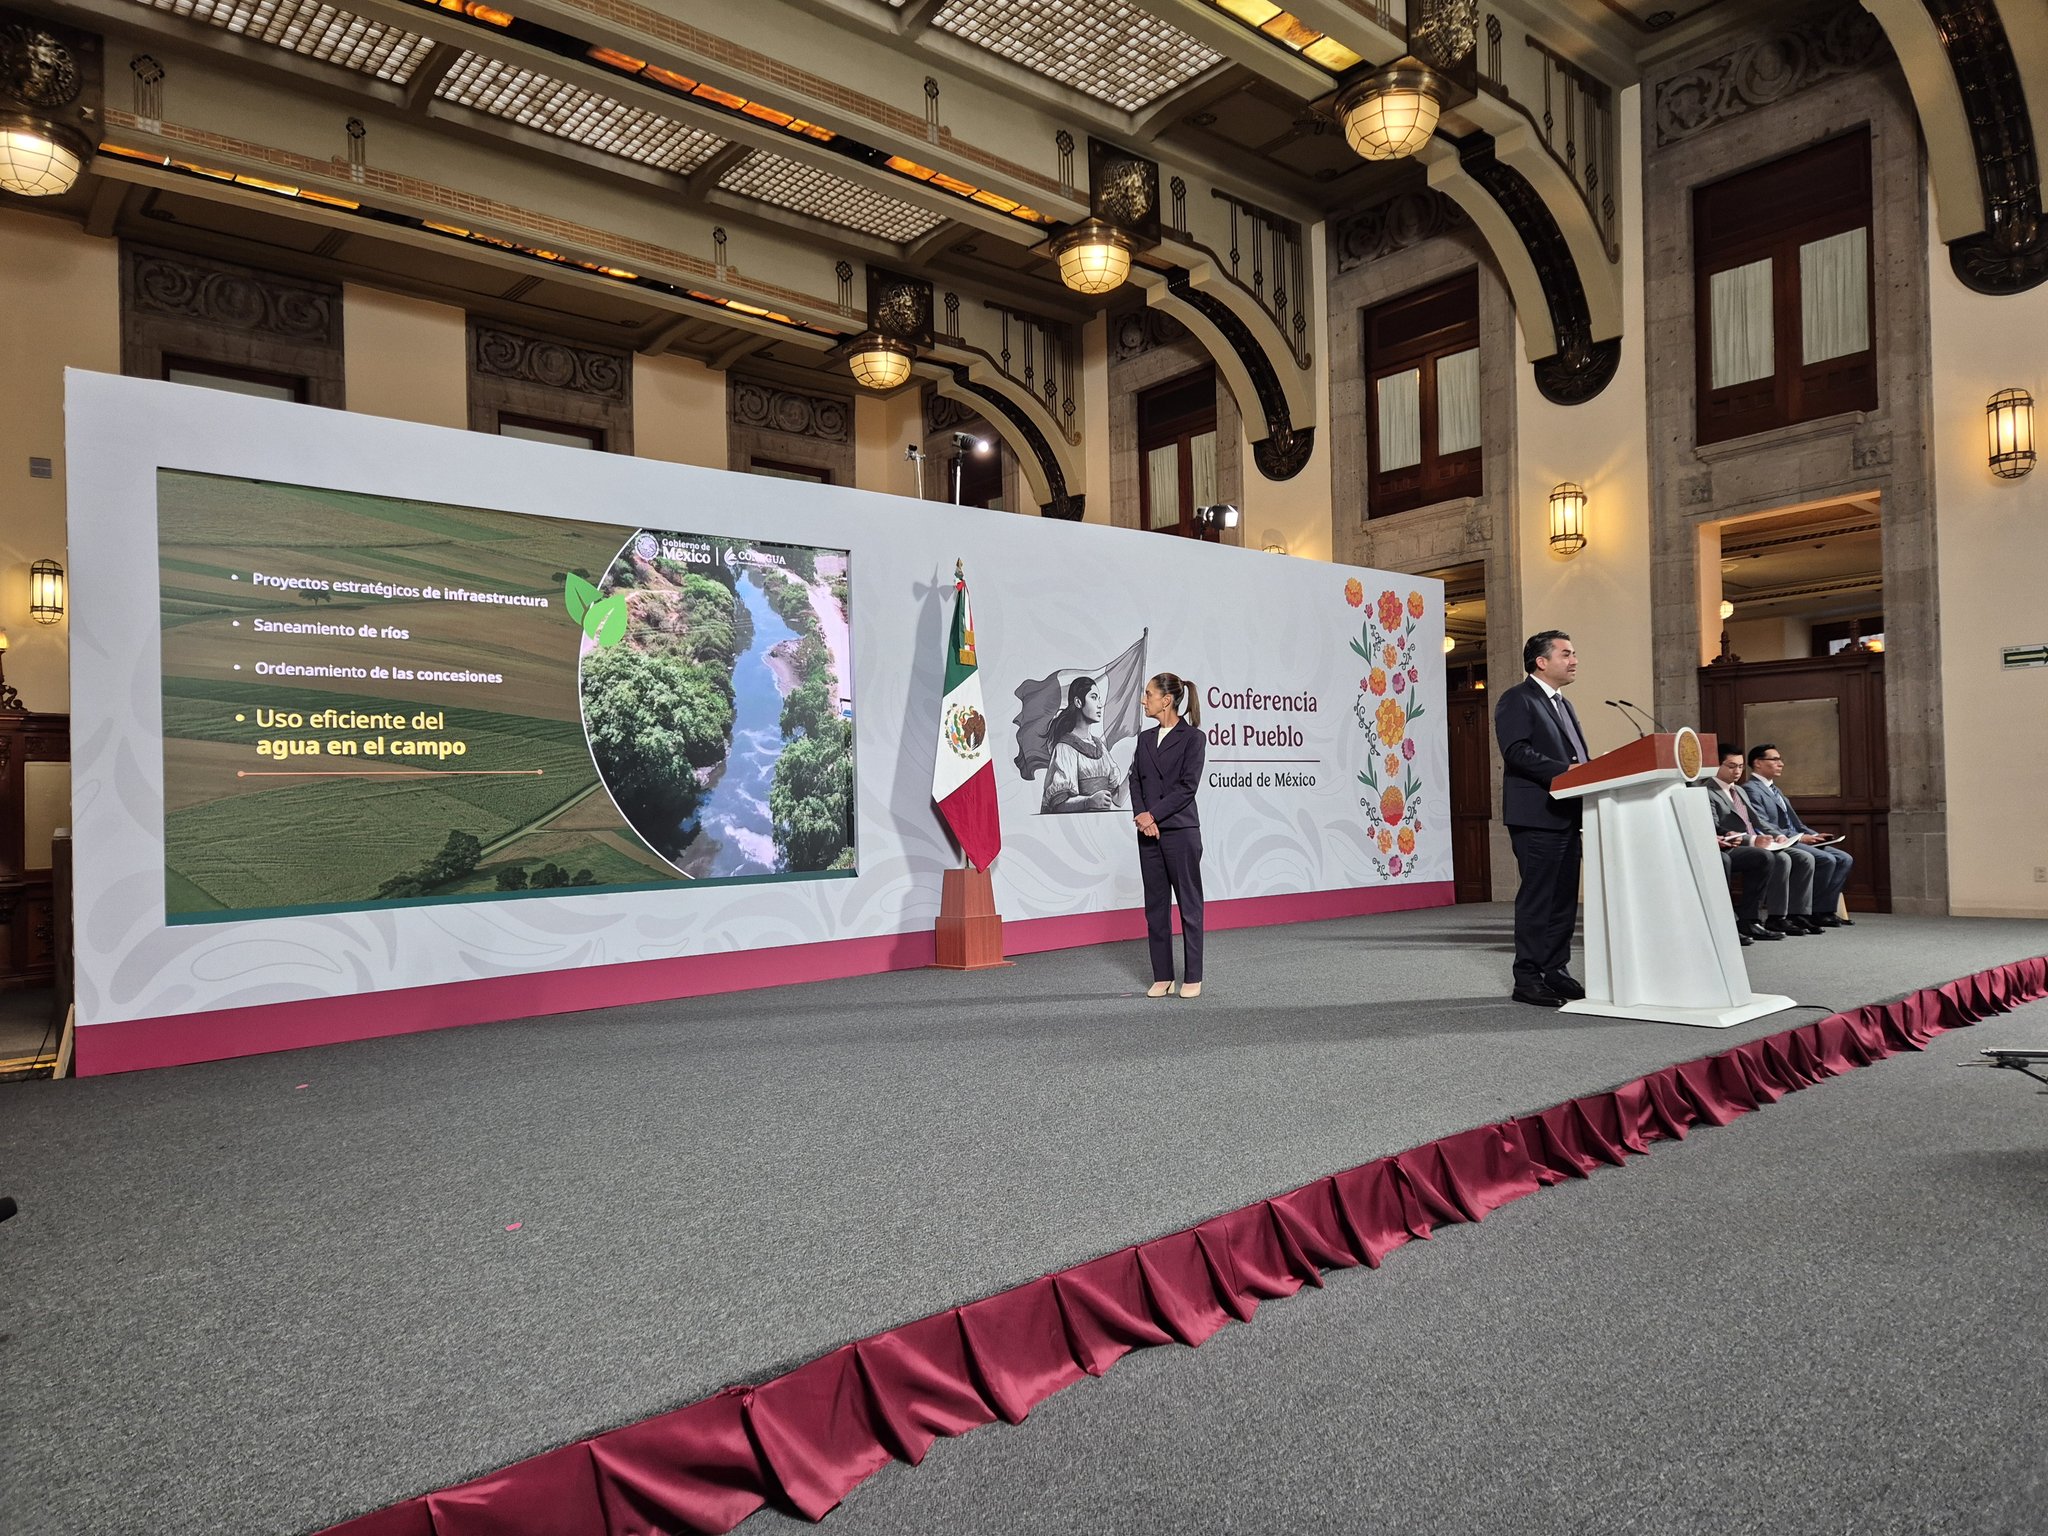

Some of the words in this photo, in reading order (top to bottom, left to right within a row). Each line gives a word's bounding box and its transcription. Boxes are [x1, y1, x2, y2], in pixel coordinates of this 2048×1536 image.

[662, 538, 700, 550] Gobierno
[700, 542, 711, 552] de
[662, 546, 711, 564] México
[738, 551, 787, 564] COGUA
[252, 572, 329, 590] Proyectos
[332, 580, 421, 599] estratégicos
[422, 585, 442, 600] de
[444, 587, 549, 608] infraestructura
[253, 618, 356, 637] Saneamiento
[358, 624, 379, 638] de
[382, 625, 410, 640] ríos
[254, 661, 368, 679] Ordenamiento
[369, 667, 390, 680] de
[392, 667, 415, 681] las
[416, 670, 504, 684] concesiones
[1207, 686, 1317, 712] Conferencia
[255, 709, 304, 728] Uso
[309, 709, 407, 729] eficiente
[411, 711, 444, 730] del
[1208, 723, 1237, 747] del
[1243, 724, 1304, 748] Pueblo
[256, 739, 321, 760] agua
[326, 741, 358, 755] en
[362, 736, 385, 756] el
[389, 740, 467, 760] campo
[1208, 771, 1253, 788] Ciudad
[1256, 771, 1271, 788] de
[1274, 771, 1316, 787] México
